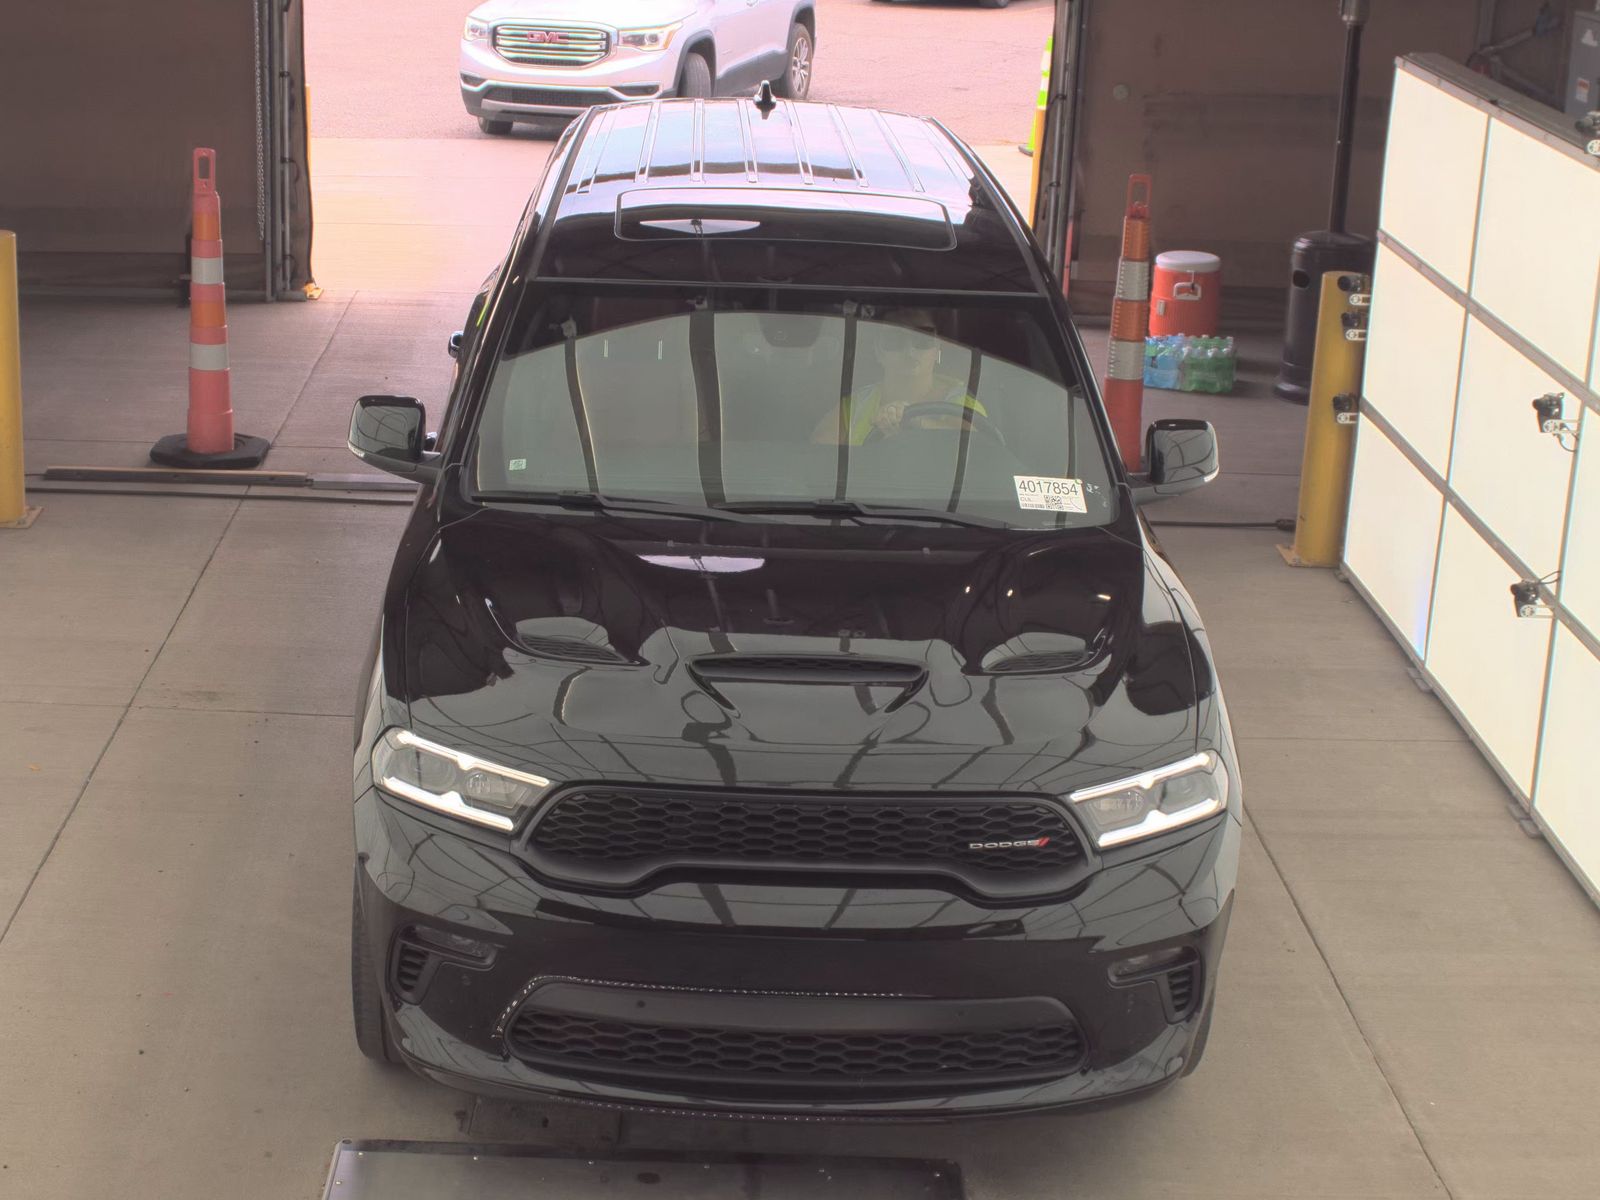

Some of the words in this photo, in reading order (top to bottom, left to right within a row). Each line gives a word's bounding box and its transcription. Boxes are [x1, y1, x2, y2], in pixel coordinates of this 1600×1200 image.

[527, 31, 569, 44] GMC
[1019, 480, 1078, 496] 4017854
[969, 840, 1039, 849] DODGE
